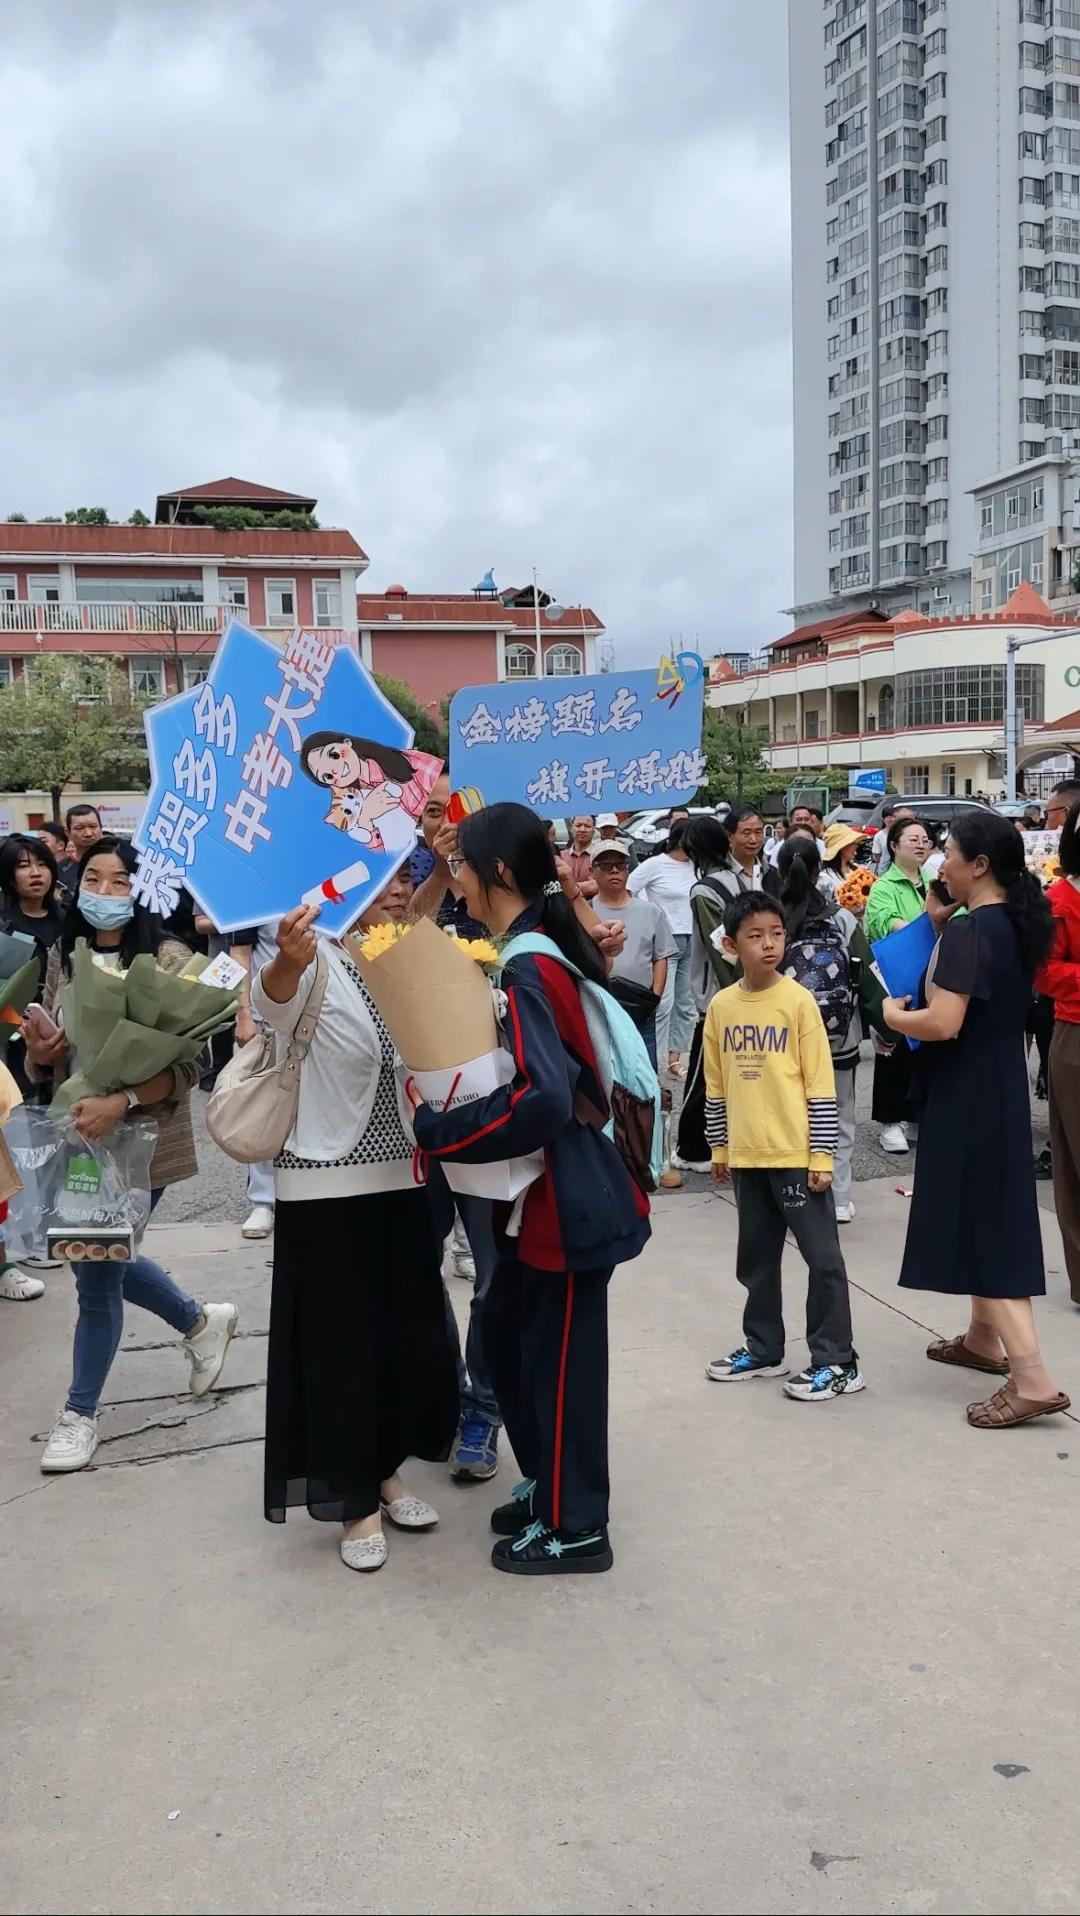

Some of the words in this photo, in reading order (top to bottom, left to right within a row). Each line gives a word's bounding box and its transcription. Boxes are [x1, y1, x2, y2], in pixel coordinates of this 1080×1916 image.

[223, 626, 336, 854] 中考大捷
[457, 687, 643, 748] 金榜题名
[526, 747, 709, 805] 旗开得胜
[129, 683, 238, 919] 恭贺多多
